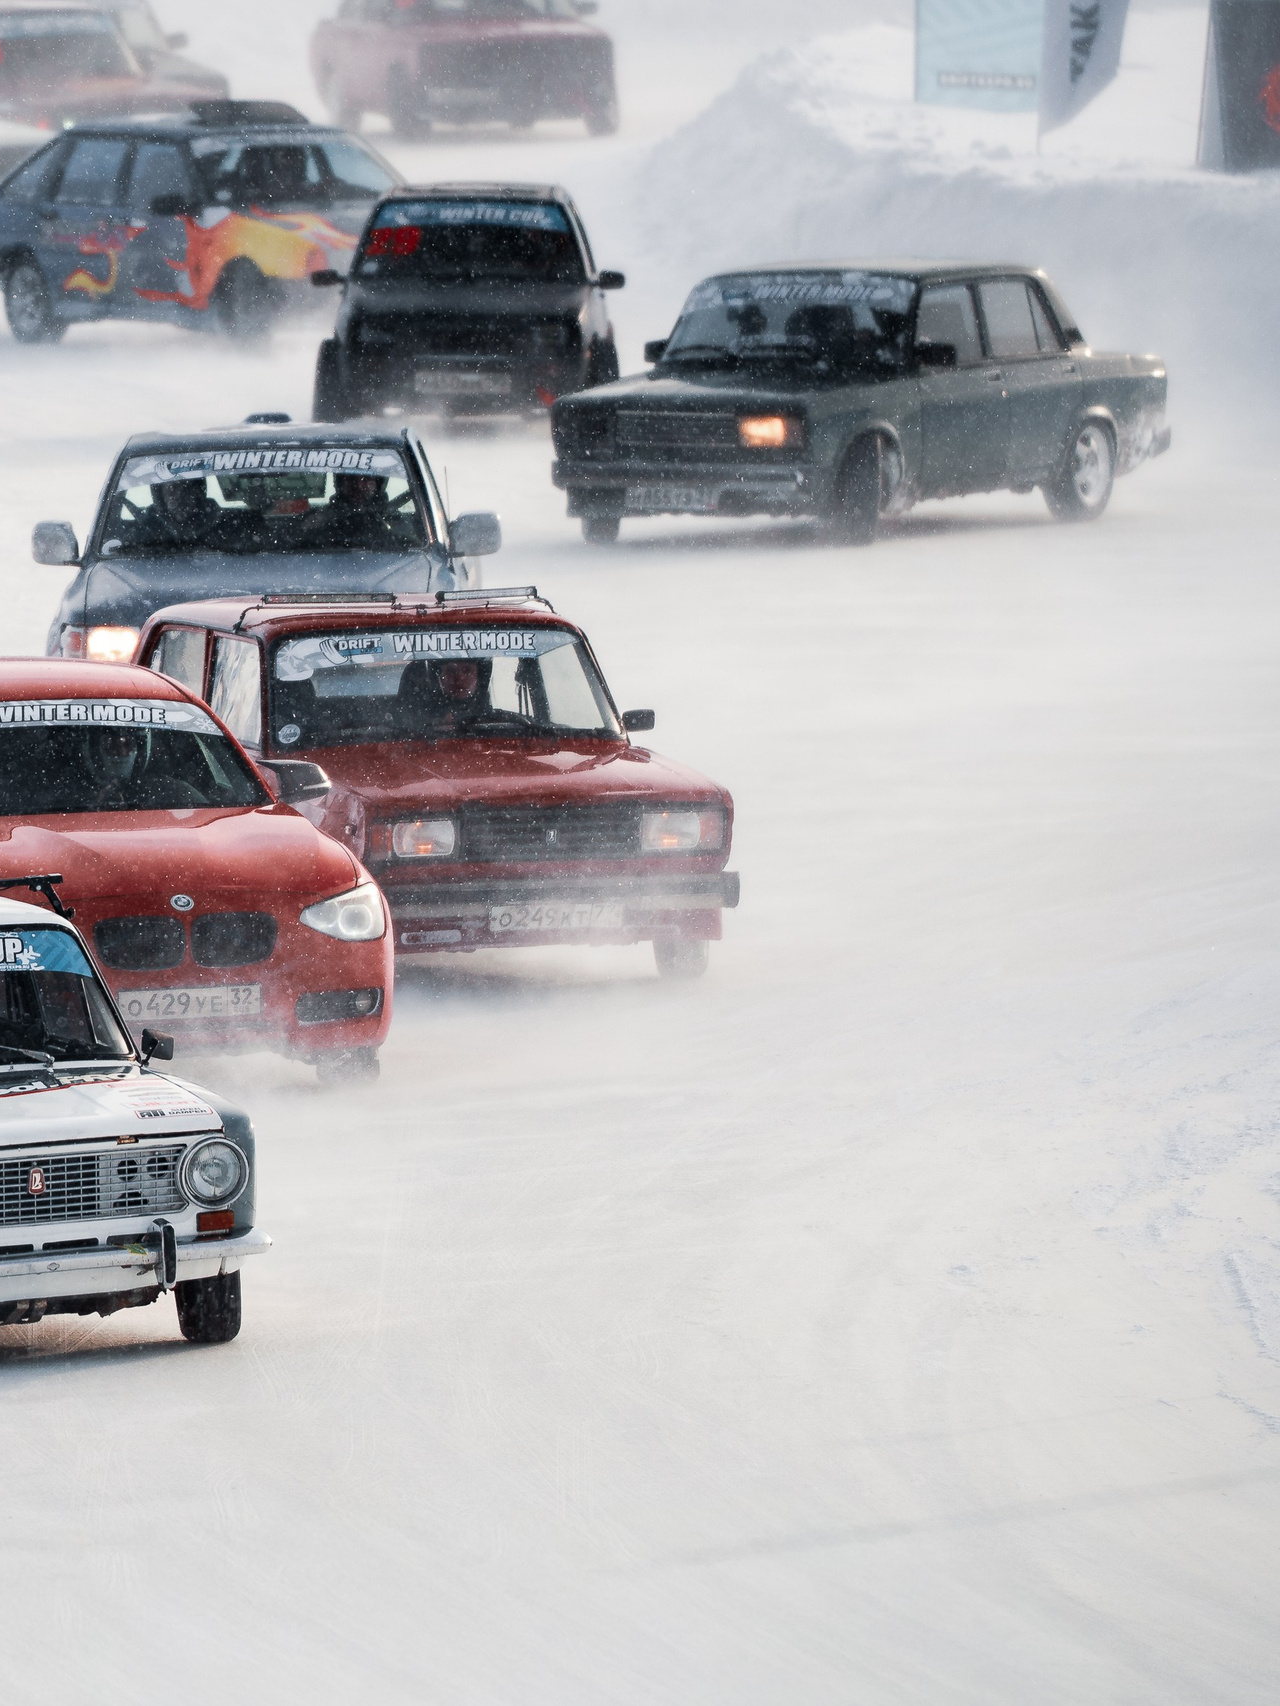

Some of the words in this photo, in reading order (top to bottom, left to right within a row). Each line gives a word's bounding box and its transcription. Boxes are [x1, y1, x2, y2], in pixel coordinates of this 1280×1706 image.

[171, 457, 210, 468] DRIFT
[213, 450, 302, 470] WINTER
[305, 450, 373, 470] MODE
[338, 637, 381, 650] DRIFT
[393, 631, 478, 653] WINTER
[480, 631, 536, 651] MODE
[92, 704, 166, 725] MODE
[230, 987, 253, 1006] 32
